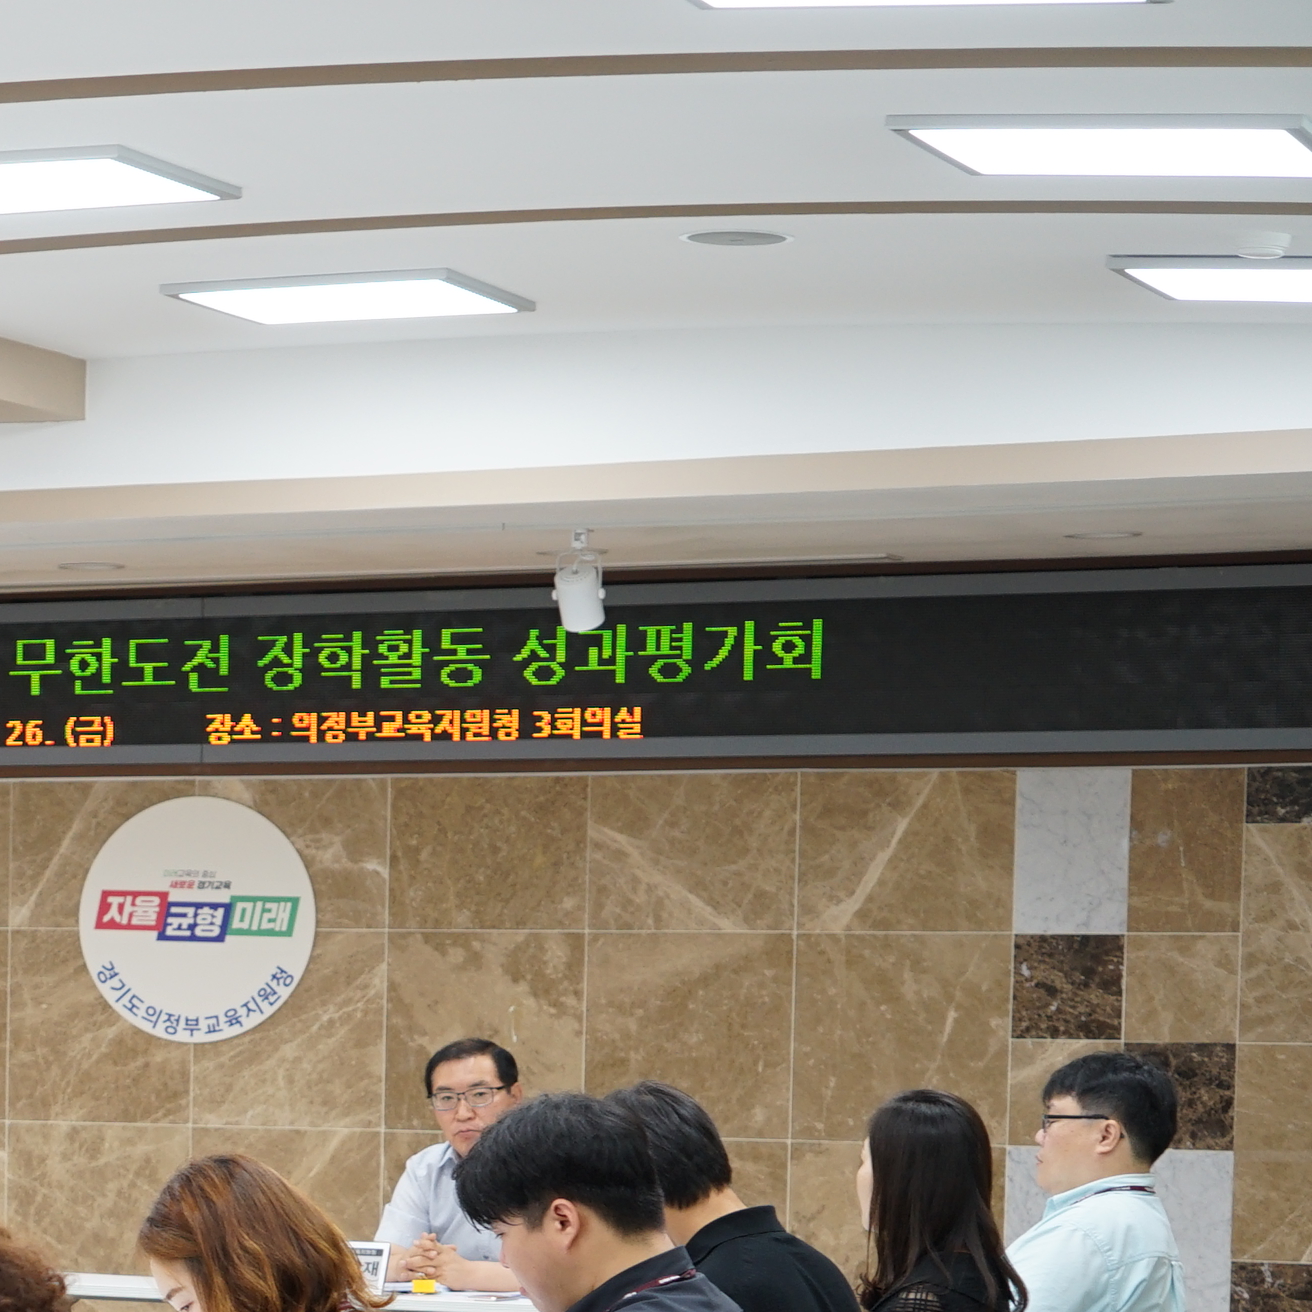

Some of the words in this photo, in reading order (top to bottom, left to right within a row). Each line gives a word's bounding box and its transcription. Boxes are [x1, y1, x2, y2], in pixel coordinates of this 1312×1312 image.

[10, 635, 230, 697] 무한도전
[258, 629, 492, 692] 장학활동
[514, 619, 824, 687] 성과평가회
[6, 720, 56, 746] 26.
[65, 716, 115, 747] (금)
[206, 714, 263, 745] 장소
[291, 709, 521, 744] 의정부교육지원청
[532, 707, 645, 741] 3회의실
[197, 880, 232, 890] 경기교육
[102, 895, 161, 926] 자율
[165, 906, 225, 937] 균형
[231, 901, 292, 932] 미래
[96, 960, 295, 1037] 경기도의정부교육지원청
